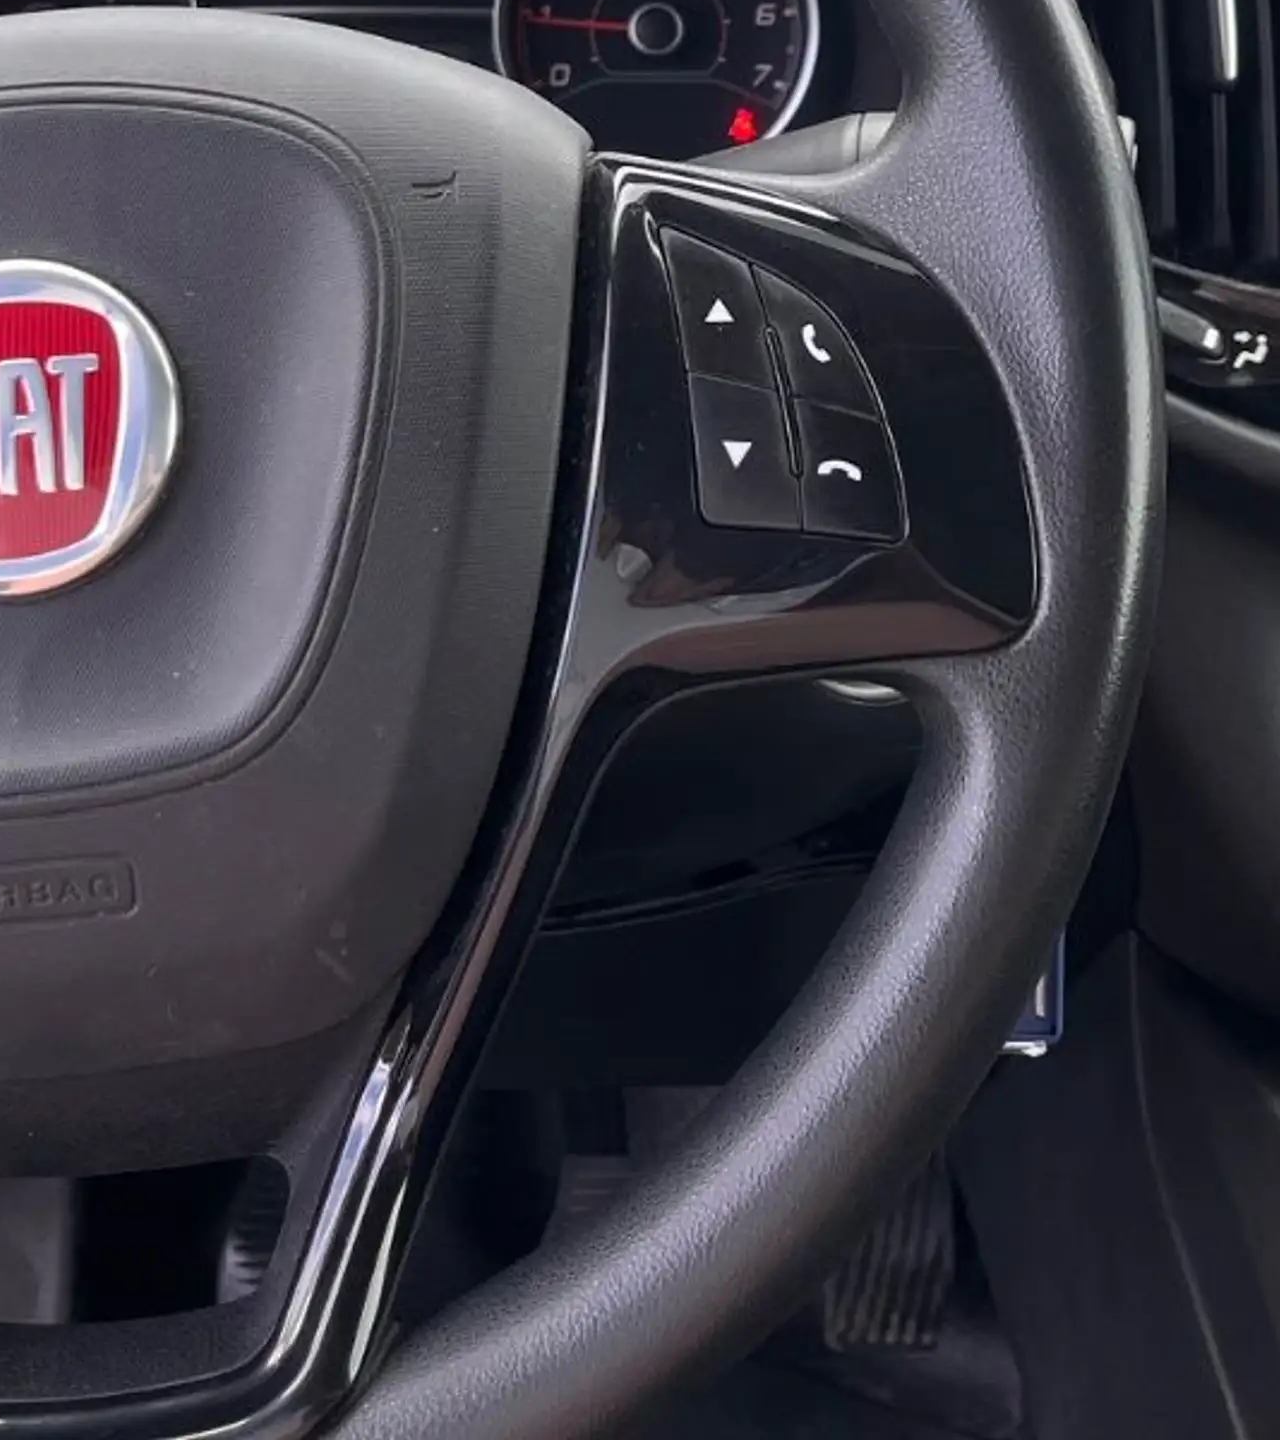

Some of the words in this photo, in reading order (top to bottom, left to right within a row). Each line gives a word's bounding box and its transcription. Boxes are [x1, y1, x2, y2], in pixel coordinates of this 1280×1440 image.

[755, 4, 776, 26] 6
[550, 63, 570, 85] 0
[752, 64, 772, 86] 7
